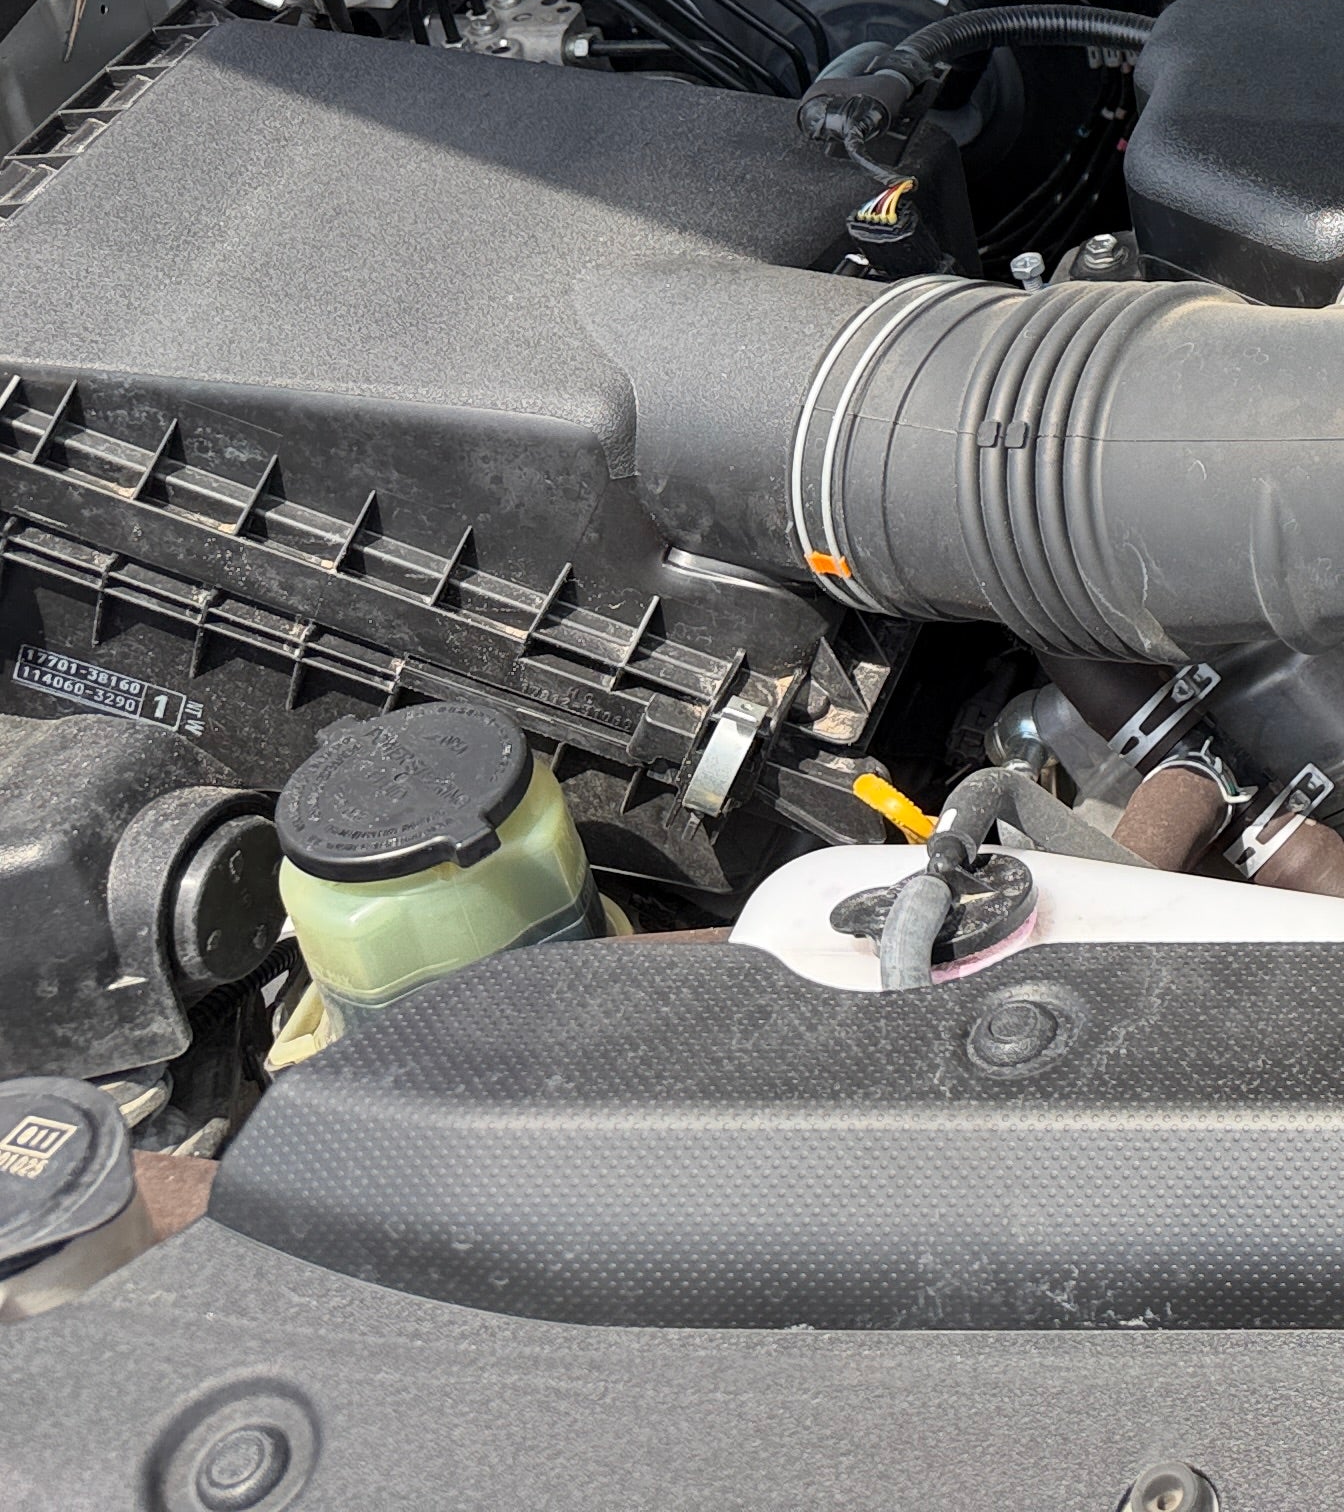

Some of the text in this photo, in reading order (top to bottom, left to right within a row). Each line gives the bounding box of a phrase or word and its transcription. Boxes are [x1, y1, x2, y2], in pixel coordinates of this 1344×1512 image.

[22, 666, 137, 713] 114060-3290
[26, 648, 141, 696] 17701-38160
[153, 694, 169, 719] 1
